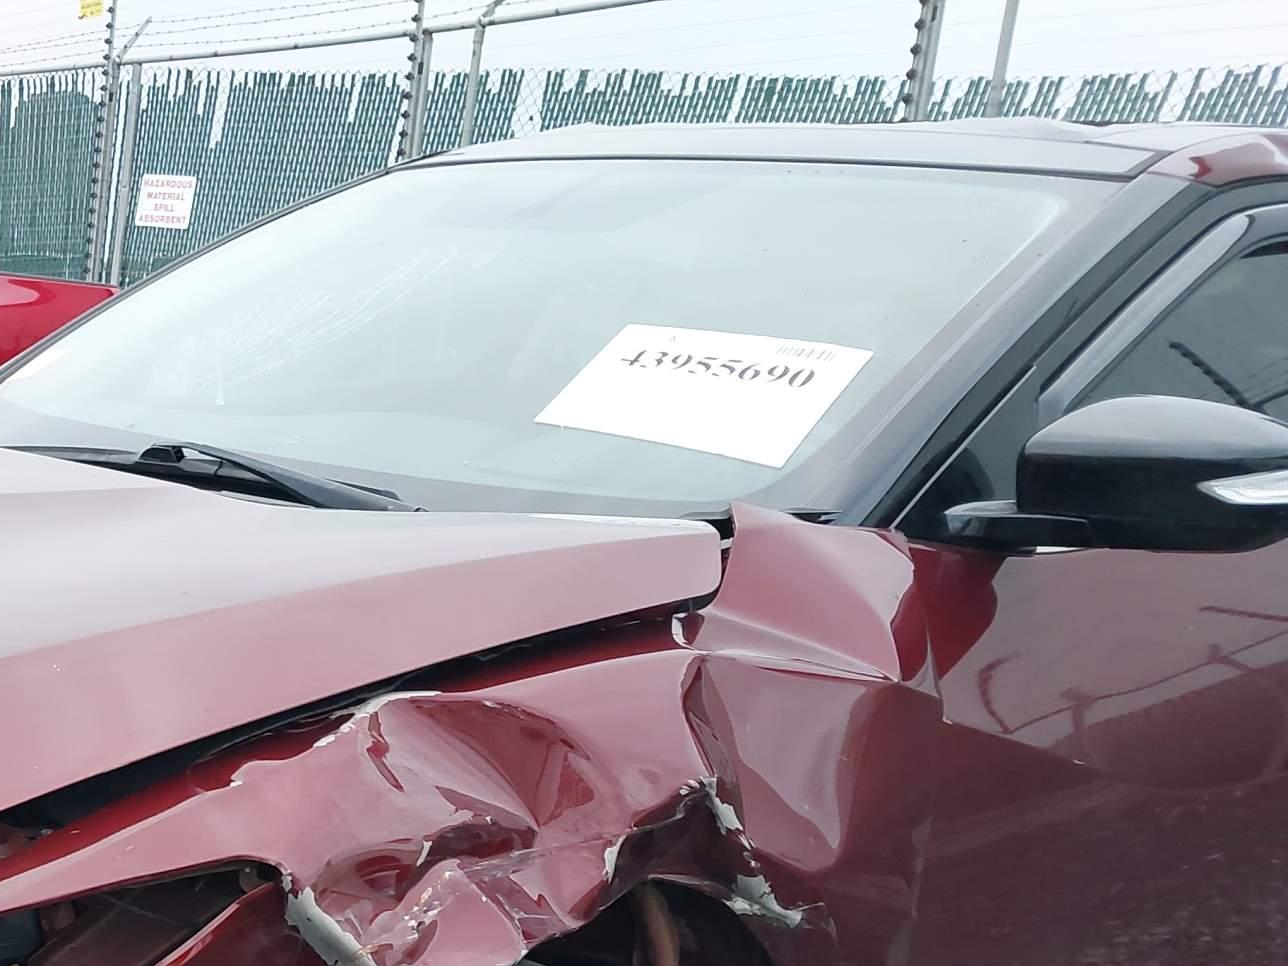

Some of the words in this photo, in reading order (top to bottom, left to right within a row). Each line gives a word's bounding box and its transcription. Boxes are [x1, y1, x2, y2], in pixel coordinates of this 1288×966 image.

[143, 177, 193, 189] HAZARDOUS
[146, 191, 185, 201] MATERIAL
[153, 202, 175, 212] SPILL
[138, 213, 186, 224] ABSORBENT
[620, 348, 816, 389] 43955690
